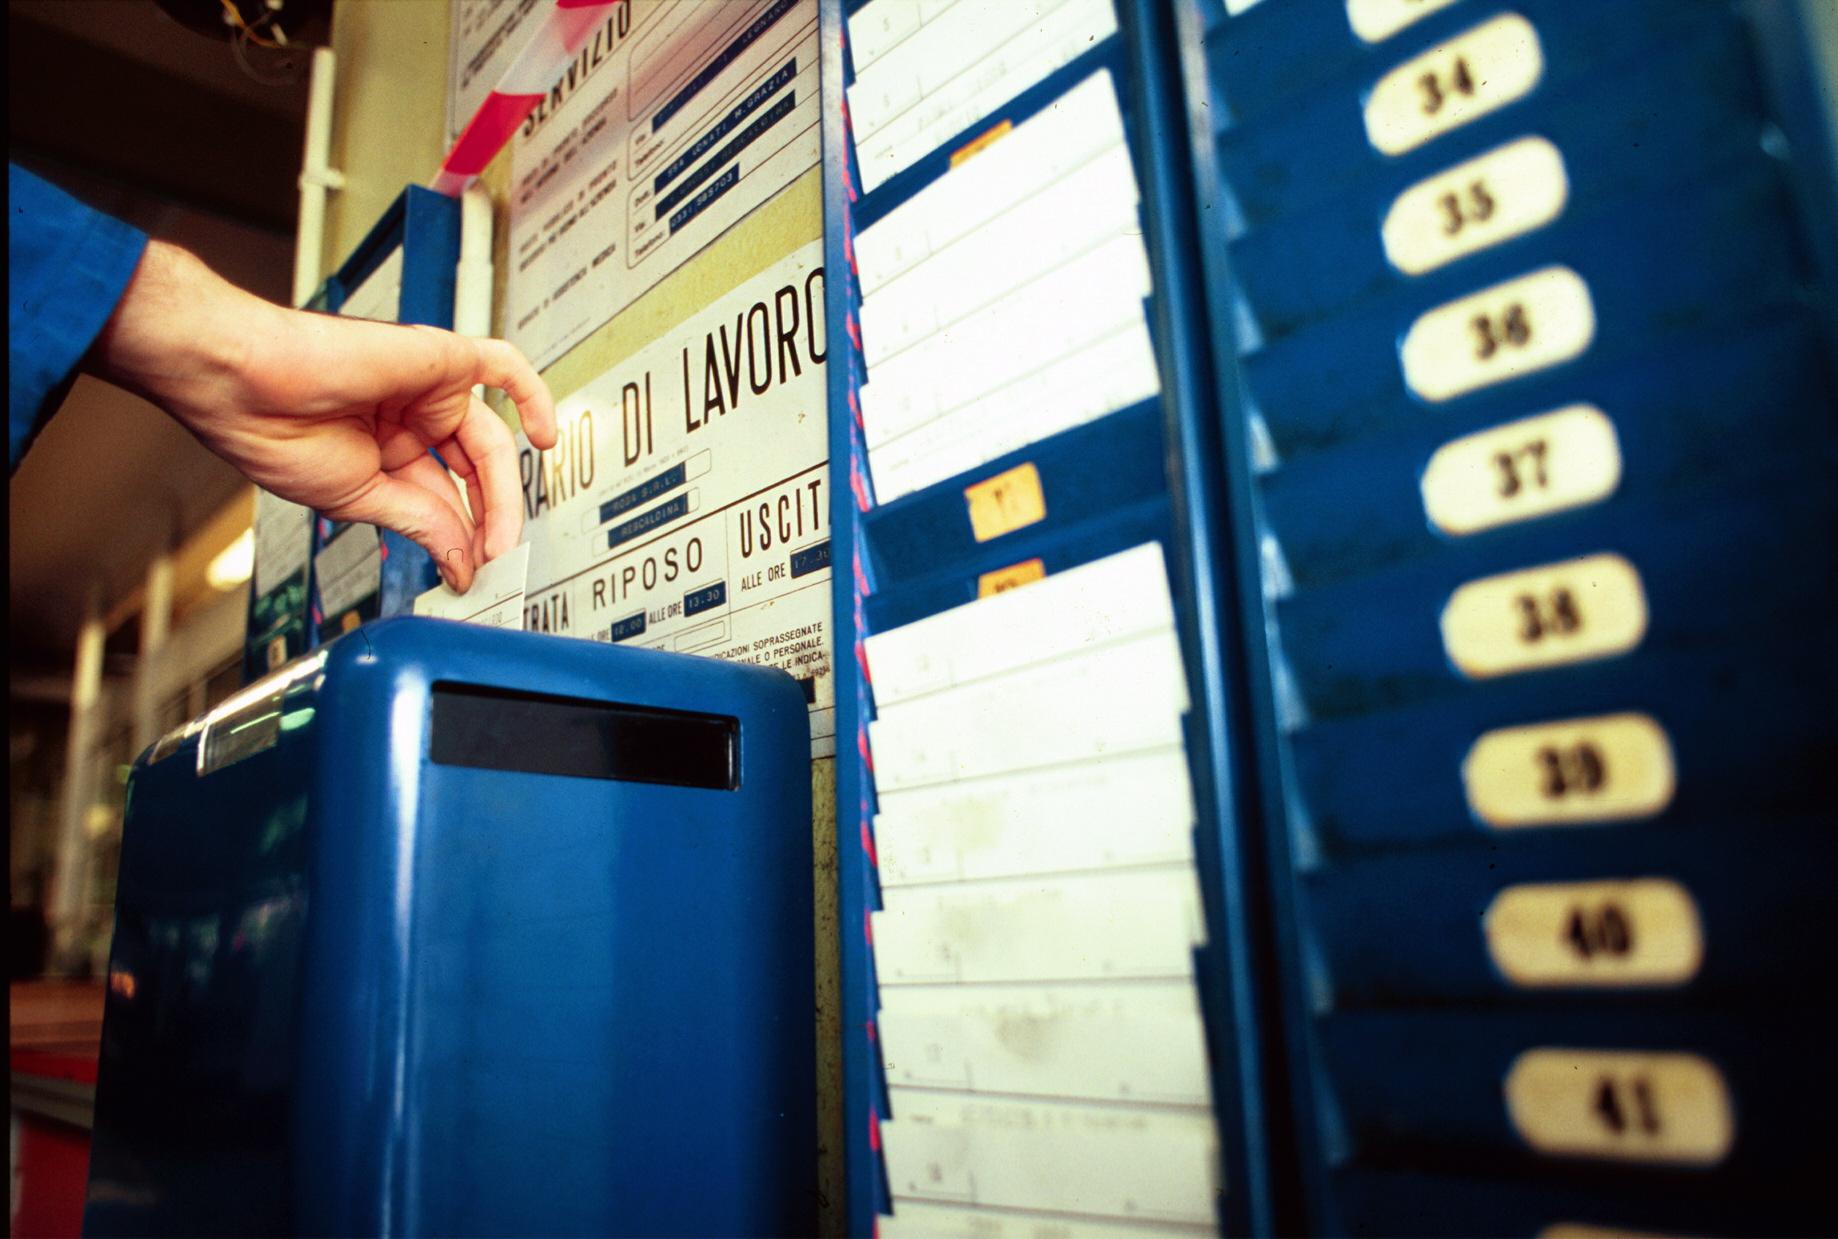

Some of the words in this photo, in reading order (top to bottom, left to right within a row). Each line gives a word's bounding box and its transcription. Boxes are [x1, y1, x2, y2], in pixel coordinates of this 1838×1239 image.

[1415, 54, 1475, 117] 34
[1437, 180, 1497, 238] 35
[1469, 302, 1531, 362] 36
[520, 409, 594, 520] RARIO
[622, 371, 653, 467] DI
[683, 266, 828, 434] LAVORO
[1493, 438, 1549, 500] 37
[593, 537, 703, 611] RIPOSO
[740, 479, 822, 559] USCIT
[648, 606, 667, 624] ALLE
[667, 601, 683, 618] ORE
[688, 590, 720, 608] 13.30
[741, 571, 762, 592] ALLE
[767, 562, 786, 582] ORE
[753, 621, 823, 651] SOPRASSEGNATE
[1563, 899, 1634, 961] 40
[1589, 1073, 1660, 1139] 41
